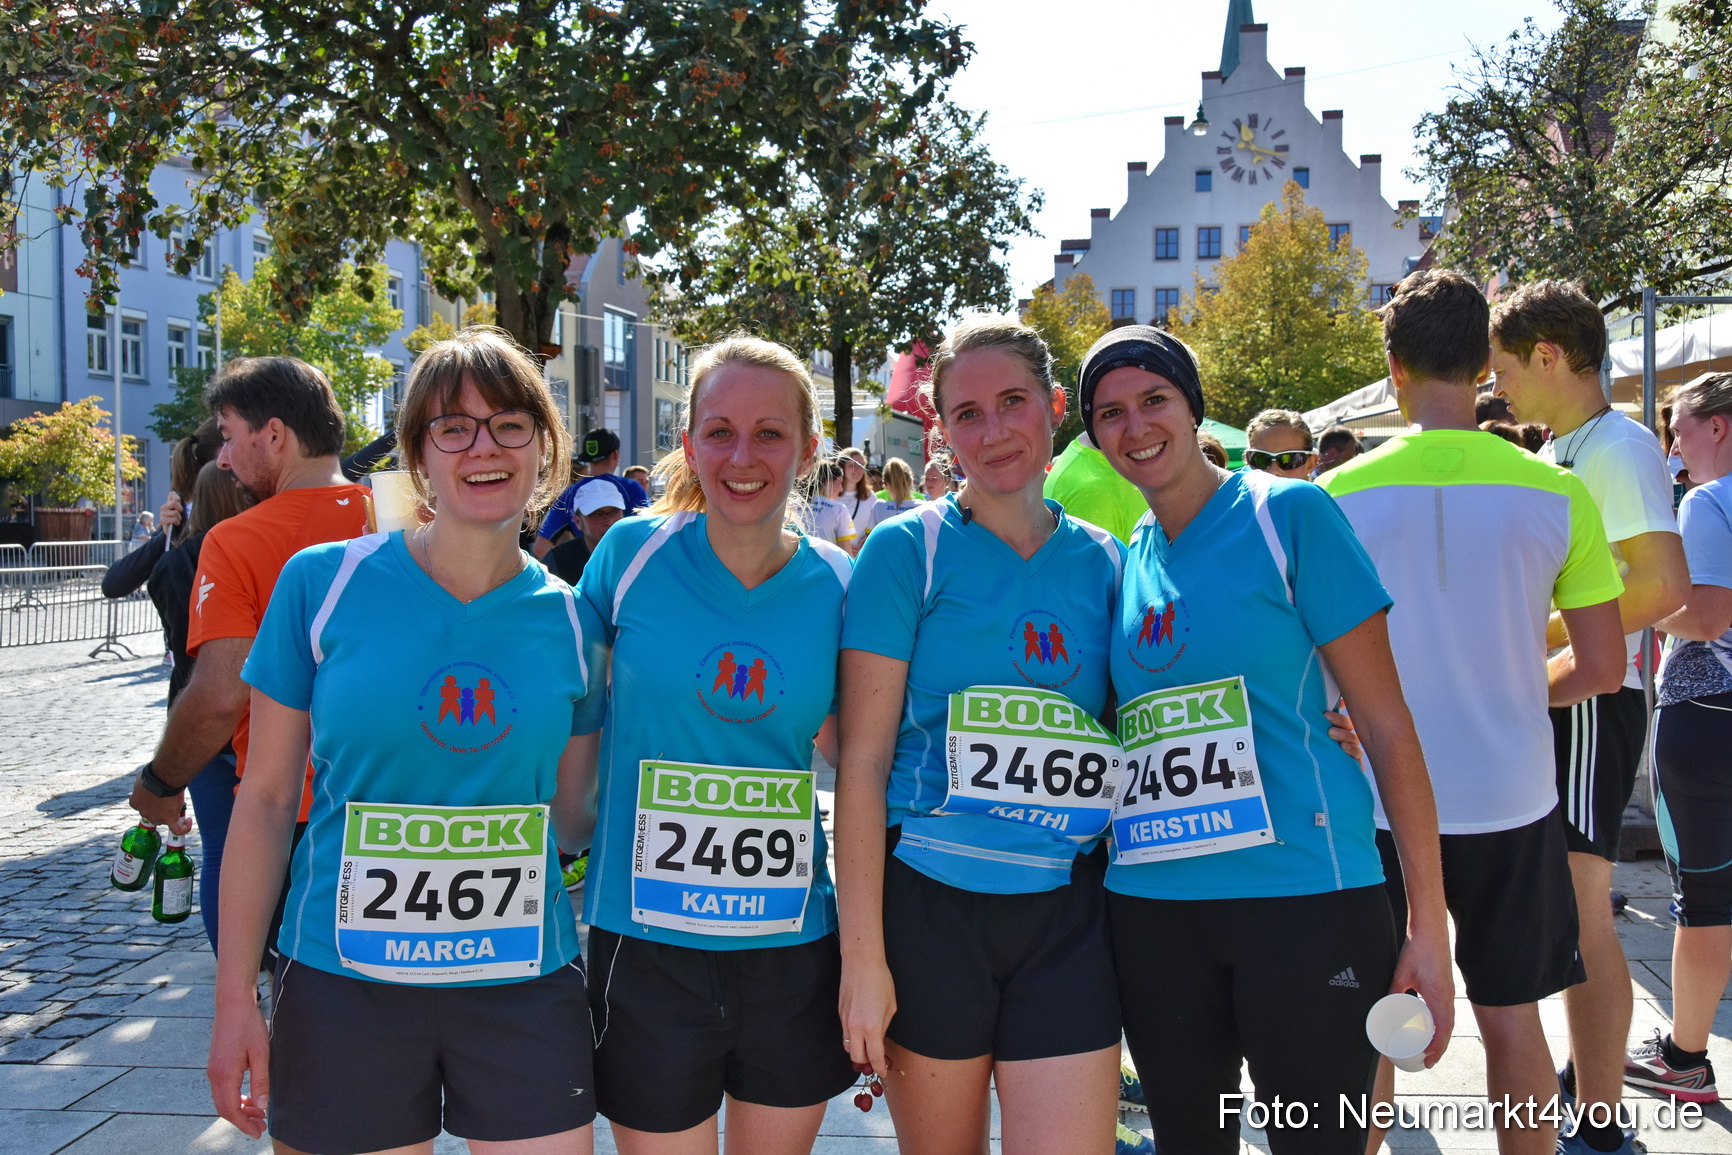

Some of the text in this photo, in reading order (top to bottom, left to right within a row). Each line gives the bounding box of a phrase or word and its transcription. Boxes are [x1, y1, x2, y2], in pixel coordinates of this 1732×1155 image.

[965, 693, 1107, 738] BOCK
[1124, 690, 1229, 743] BOCK
[970, 743, 1107, 798] 2468
[1123, 742, 1236, 807] 2464
[655, 771, 798, 811] BOCK
[362, 814, 526, 851] BOCK
[988, 806, 1069, 832] KATHI
[1130, 809, 1233, 844] KERSTIN
[655, 822, 795, 877] 2469
[363, 867, 521, 921] 2467
[682, 891, 765, 915] KATHI
[385, 937, 495, 962] MARGA
[1328, 979, 1360, 988] adidas
